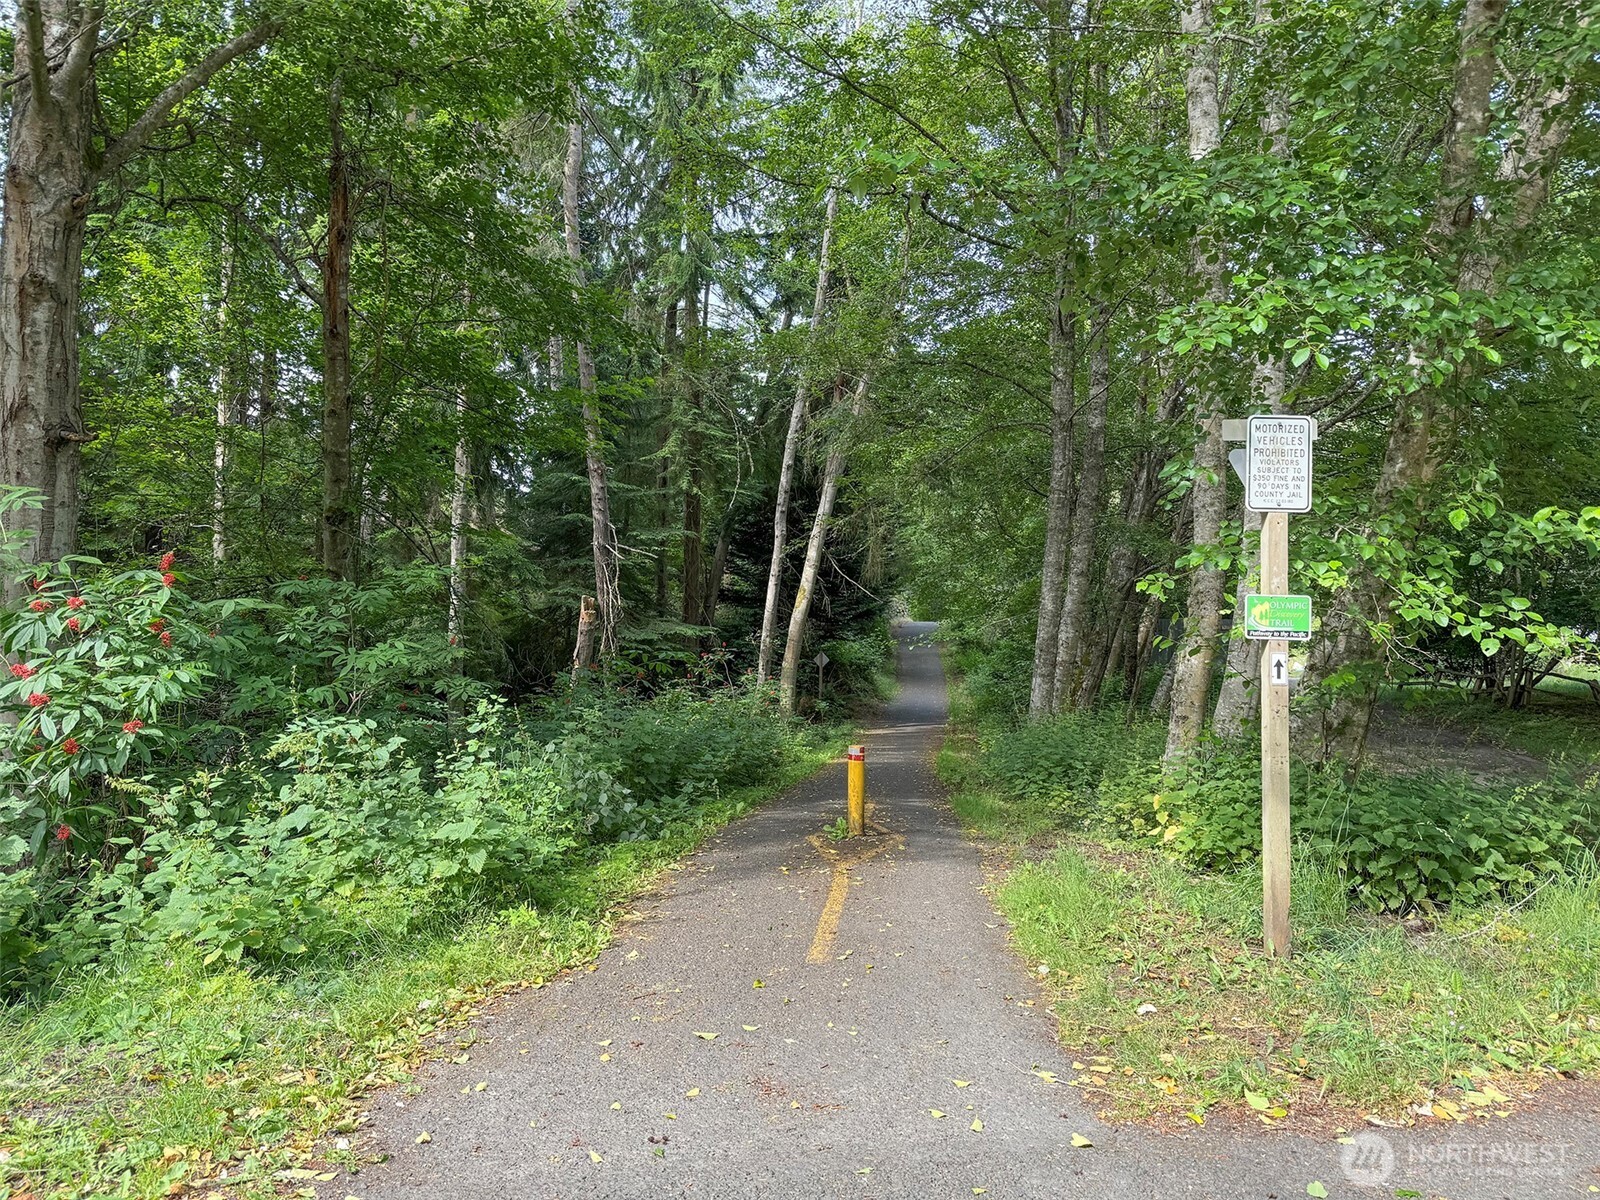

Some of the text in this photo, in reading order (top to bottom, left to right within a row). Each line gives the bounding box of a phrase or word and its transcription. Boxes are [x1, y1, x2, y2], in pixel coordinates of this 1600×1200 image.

[1255, 424, 1304, 434] MOTORIZED
[1257, 436, 1303, 445] VEHICLES
[1254, 448, 1305, 458] PROHIBITED
